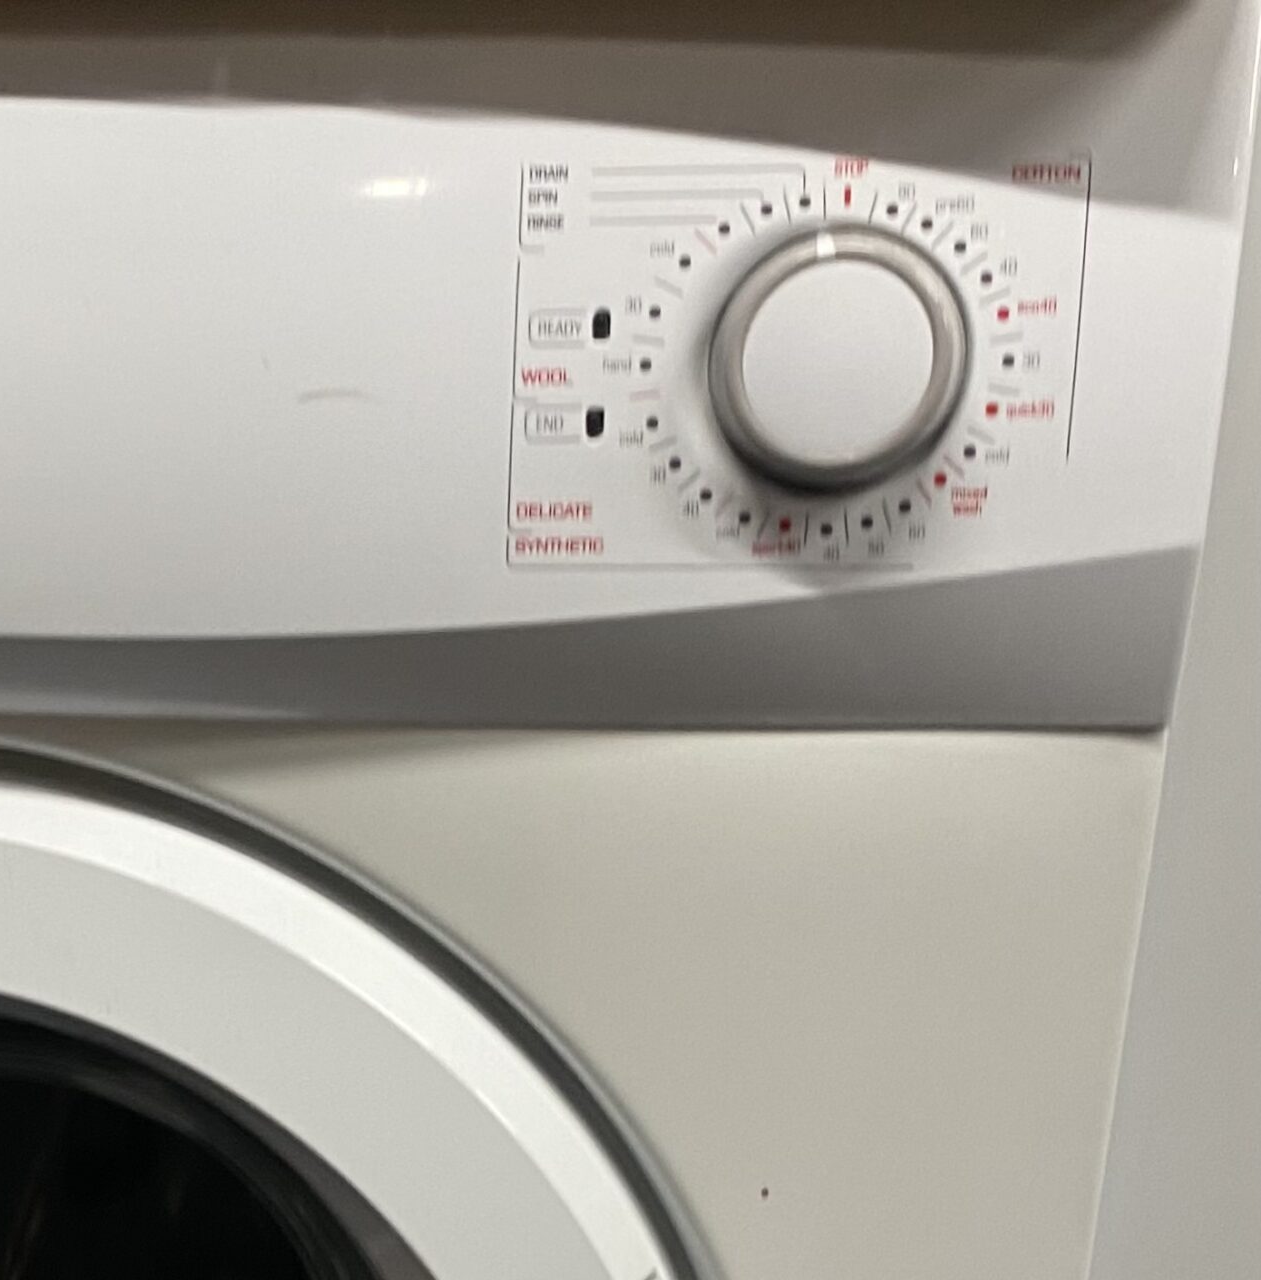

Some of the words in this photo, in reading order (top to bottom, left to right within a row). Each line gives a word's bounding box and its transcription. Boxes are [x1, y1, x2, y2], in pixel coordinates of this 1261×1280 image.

[529, 163, 569, 183] DRAIN
[834, 157, 869, 178] STOP
[1012, 163, 1082, 184] COTTON
[527, 188, 558, 208] SPIN
[527, 213, 565, 233] RINSE
[538, 319, 582, 338] READY
[521, 367, 573, 387] WOOL
[536, 414, 564, 433] END
[516, 502, 593, 521] DELICATE
[514, 536, 604, 556] SYNTHETIC
